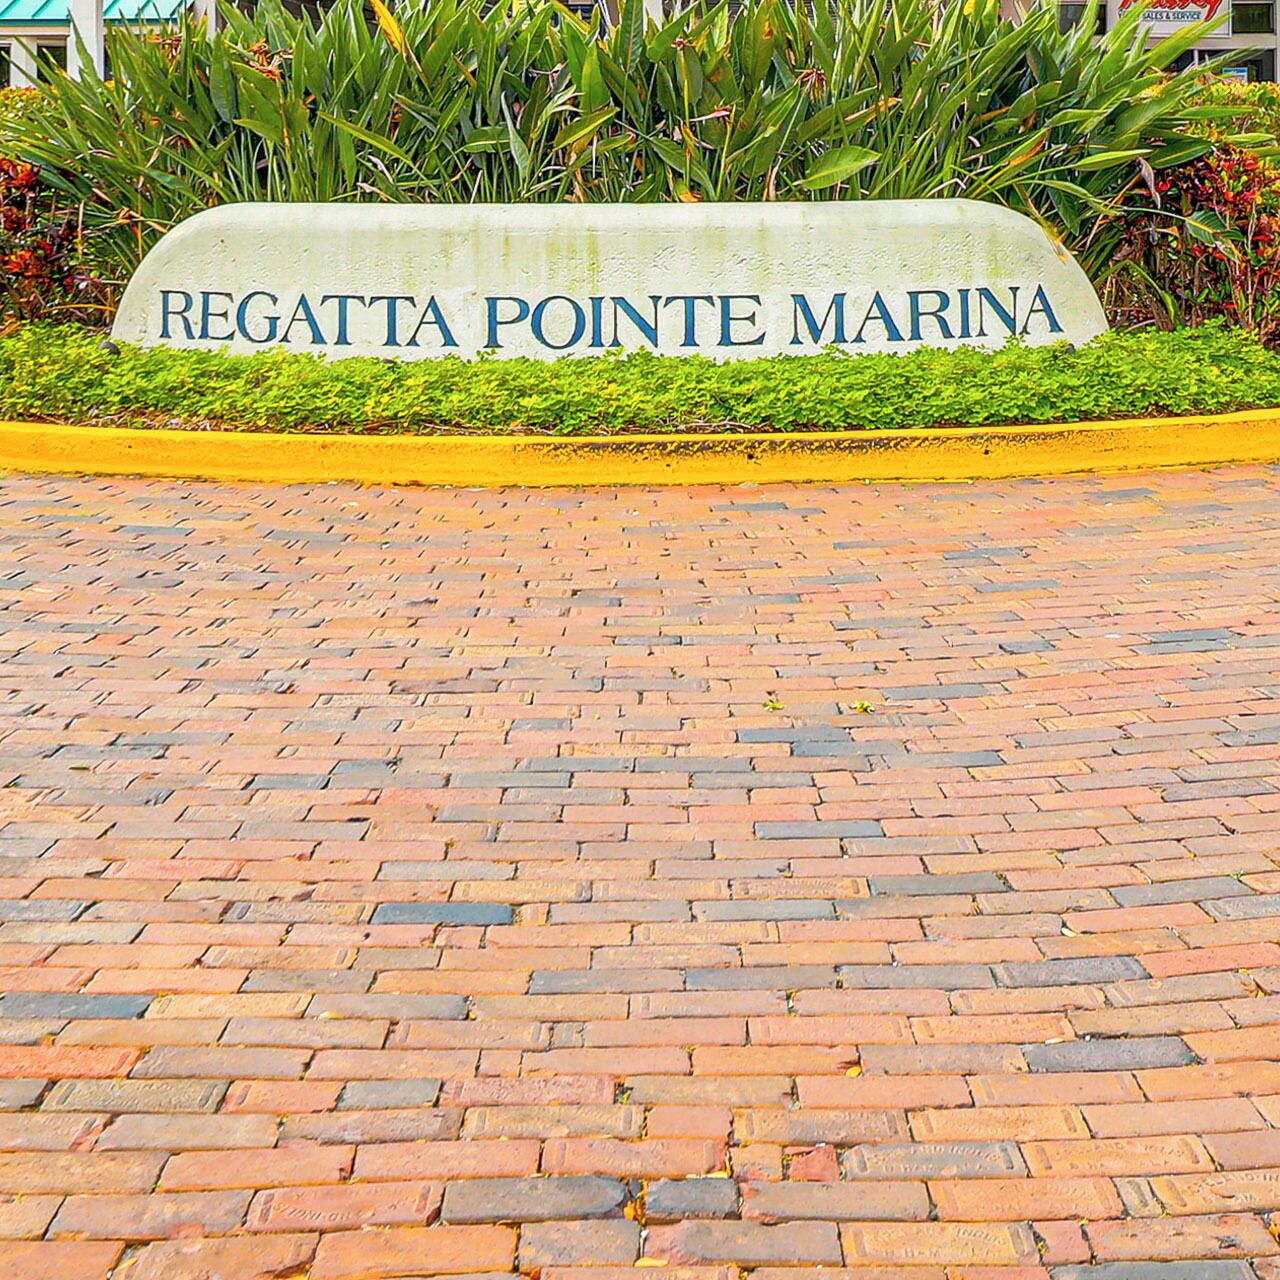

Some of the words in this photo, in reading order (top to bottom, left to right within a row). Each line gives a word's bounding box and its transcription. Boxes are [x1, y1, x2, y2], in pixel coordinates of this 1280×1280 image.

[159, 290, 459, 347] REGATTA
[483, 294, 767, 350] POINTE
[789, 283, 1064, 345] MARINA
